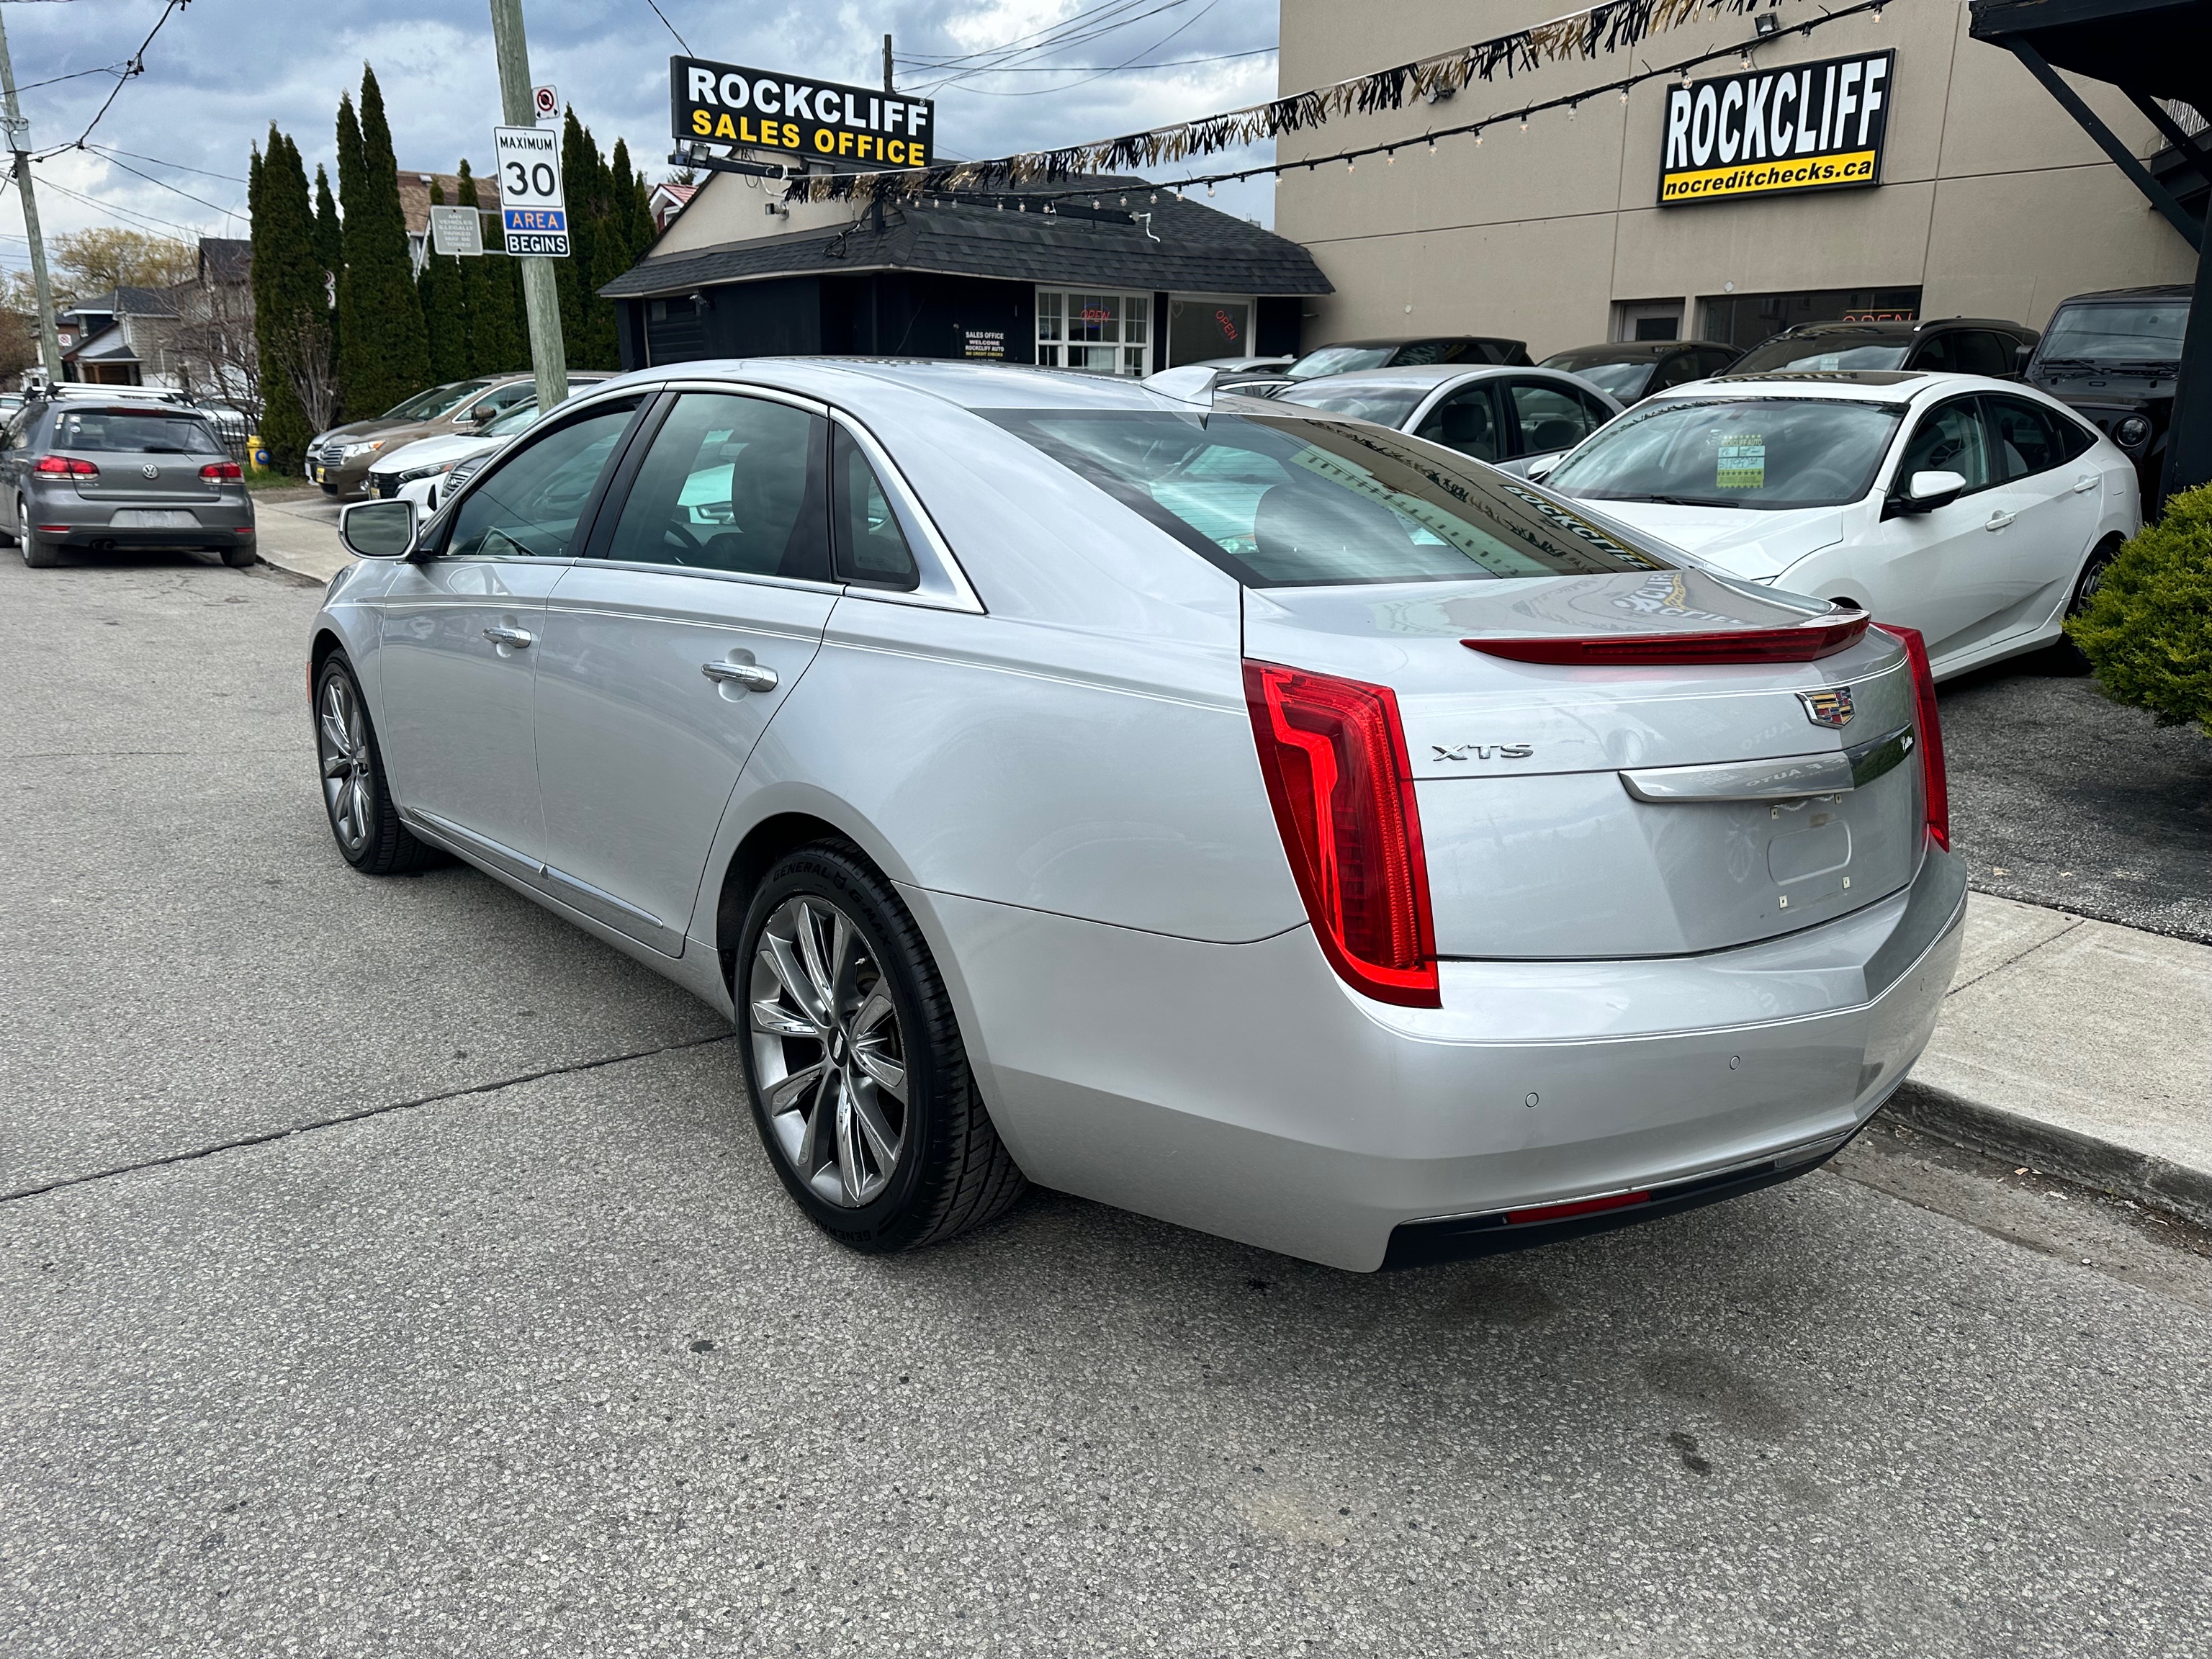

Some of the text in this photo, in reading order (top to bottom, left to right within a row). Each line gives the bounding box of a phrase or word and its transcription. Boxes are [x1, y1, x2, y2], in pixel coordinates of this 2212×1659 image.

[688, 66, 928, 136] ROCKCLIFF
[1665, 58, 1887, 169] ROCKCLIFF
[500, 136, 553, 150] MAXIMUM
[692, 109, 925, 166] SALES OFFICE
[505, 161, 555, 197] 30
[1665, 161, 1872, 195] nocreditchecks.ca
[512, 212, 559, 228] AREA
[508, 235, 567, 252] BEGINS
[1080, 309, 1110, 323] OPEN
[1215, 310, 1238, 340] OPEN
[1431, 742, 1534, 761] XTS
[773, 861, 828, 882] GENERAL
